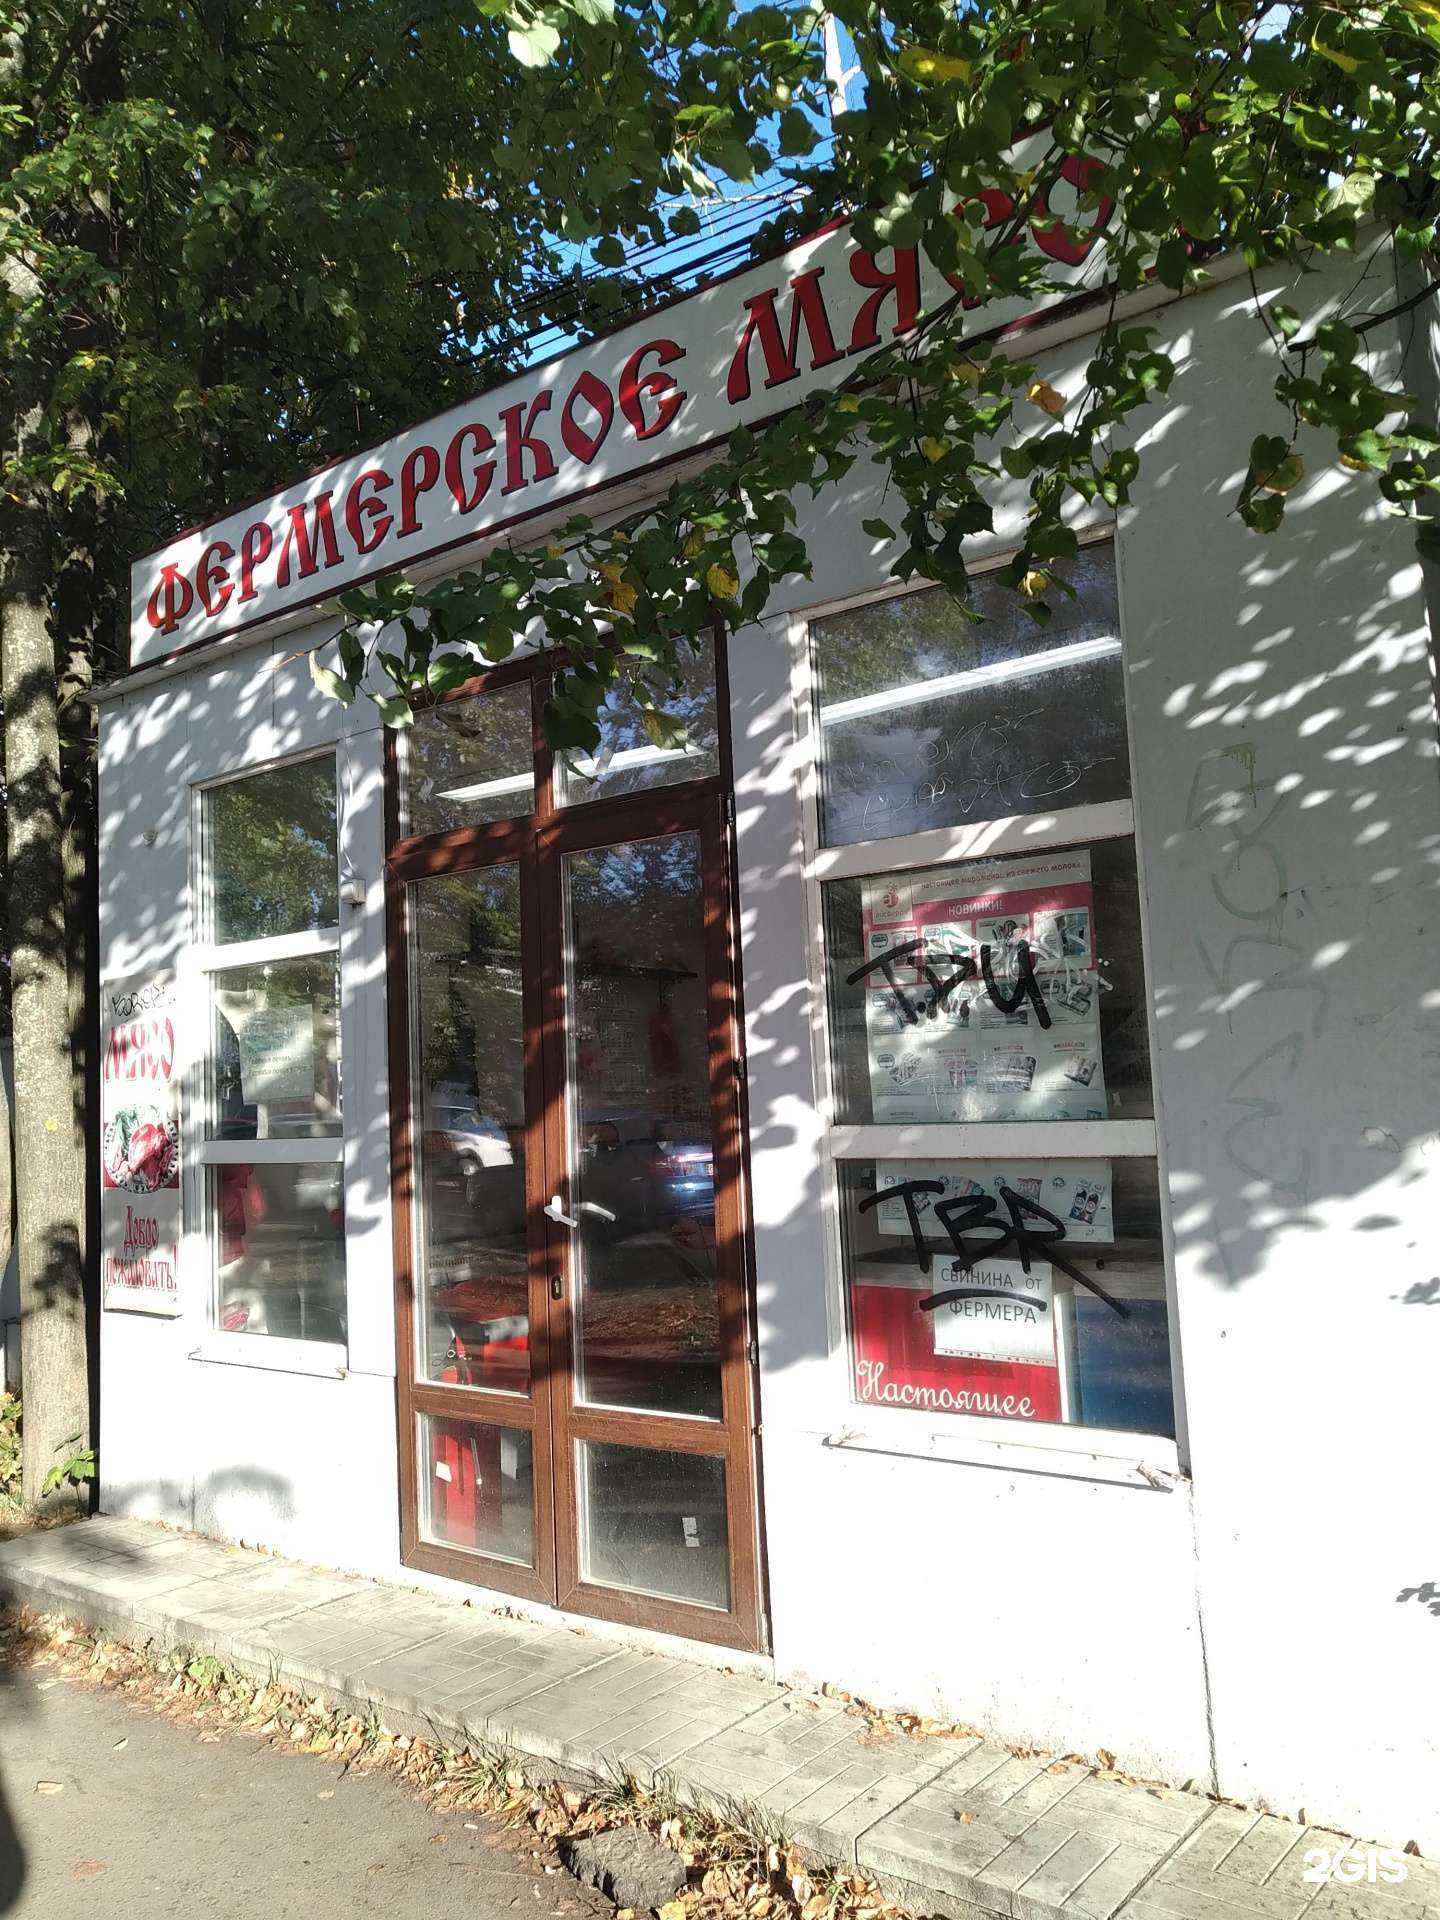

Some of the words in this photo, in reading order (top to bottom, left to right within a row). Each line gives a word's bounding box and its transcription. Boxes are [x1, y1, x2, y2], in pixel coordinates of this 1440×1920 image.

[146, 339, 688, 636] ФЕРМЕРСКОЕ
[948, 899, 1003, 917] НОВИНКИ!
[941, 1267, 1014, 1289] СВИНИНА
[949, 1299, 1037, 1324] ФЕРМЕРА
[856, 1359, 1036, 1417] Настоящее
